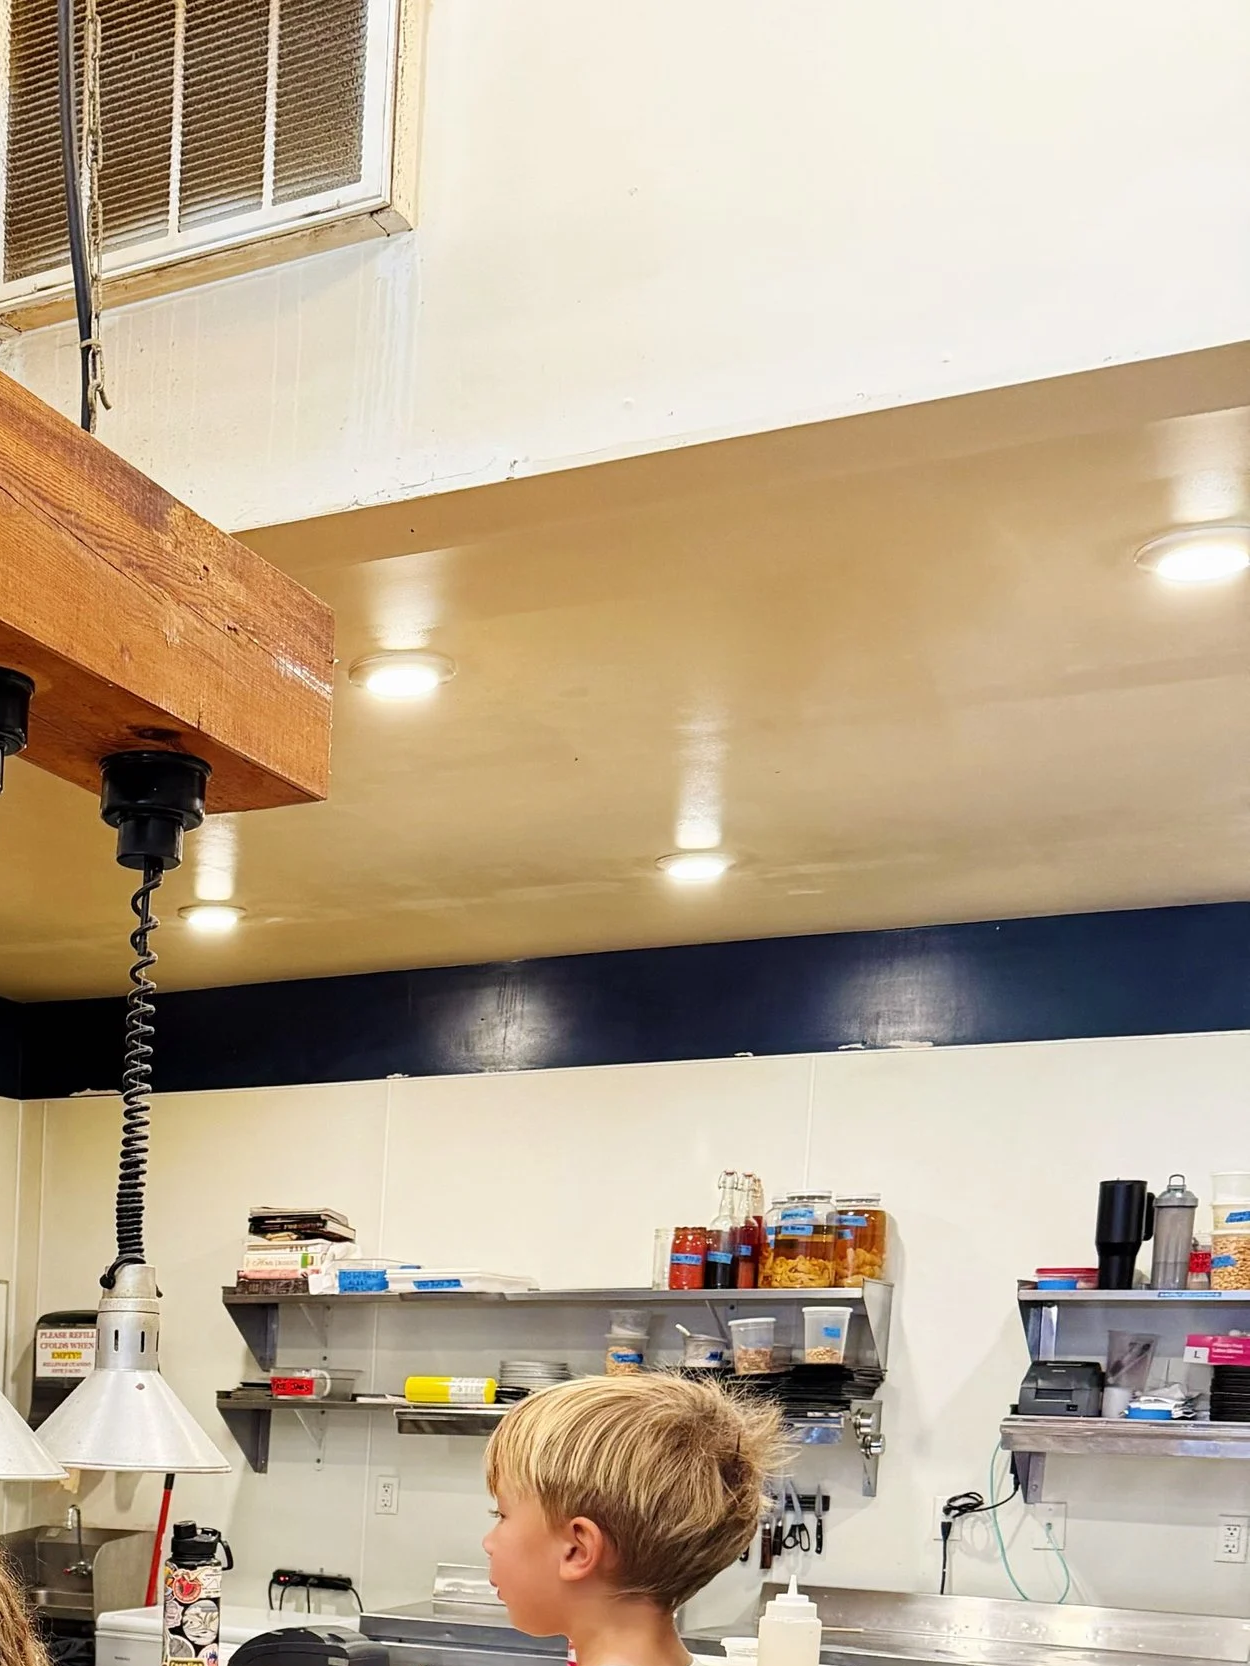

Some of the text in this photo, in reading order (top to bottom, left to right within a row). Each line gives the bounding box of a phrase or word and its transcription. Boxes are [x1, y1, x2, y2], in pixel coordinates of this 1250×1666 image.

[39, 1331, 67, 1339] PLEASE
[70, 1342, 95, 1350] WHEN
[1193, 1350, 1201, 1359] L
